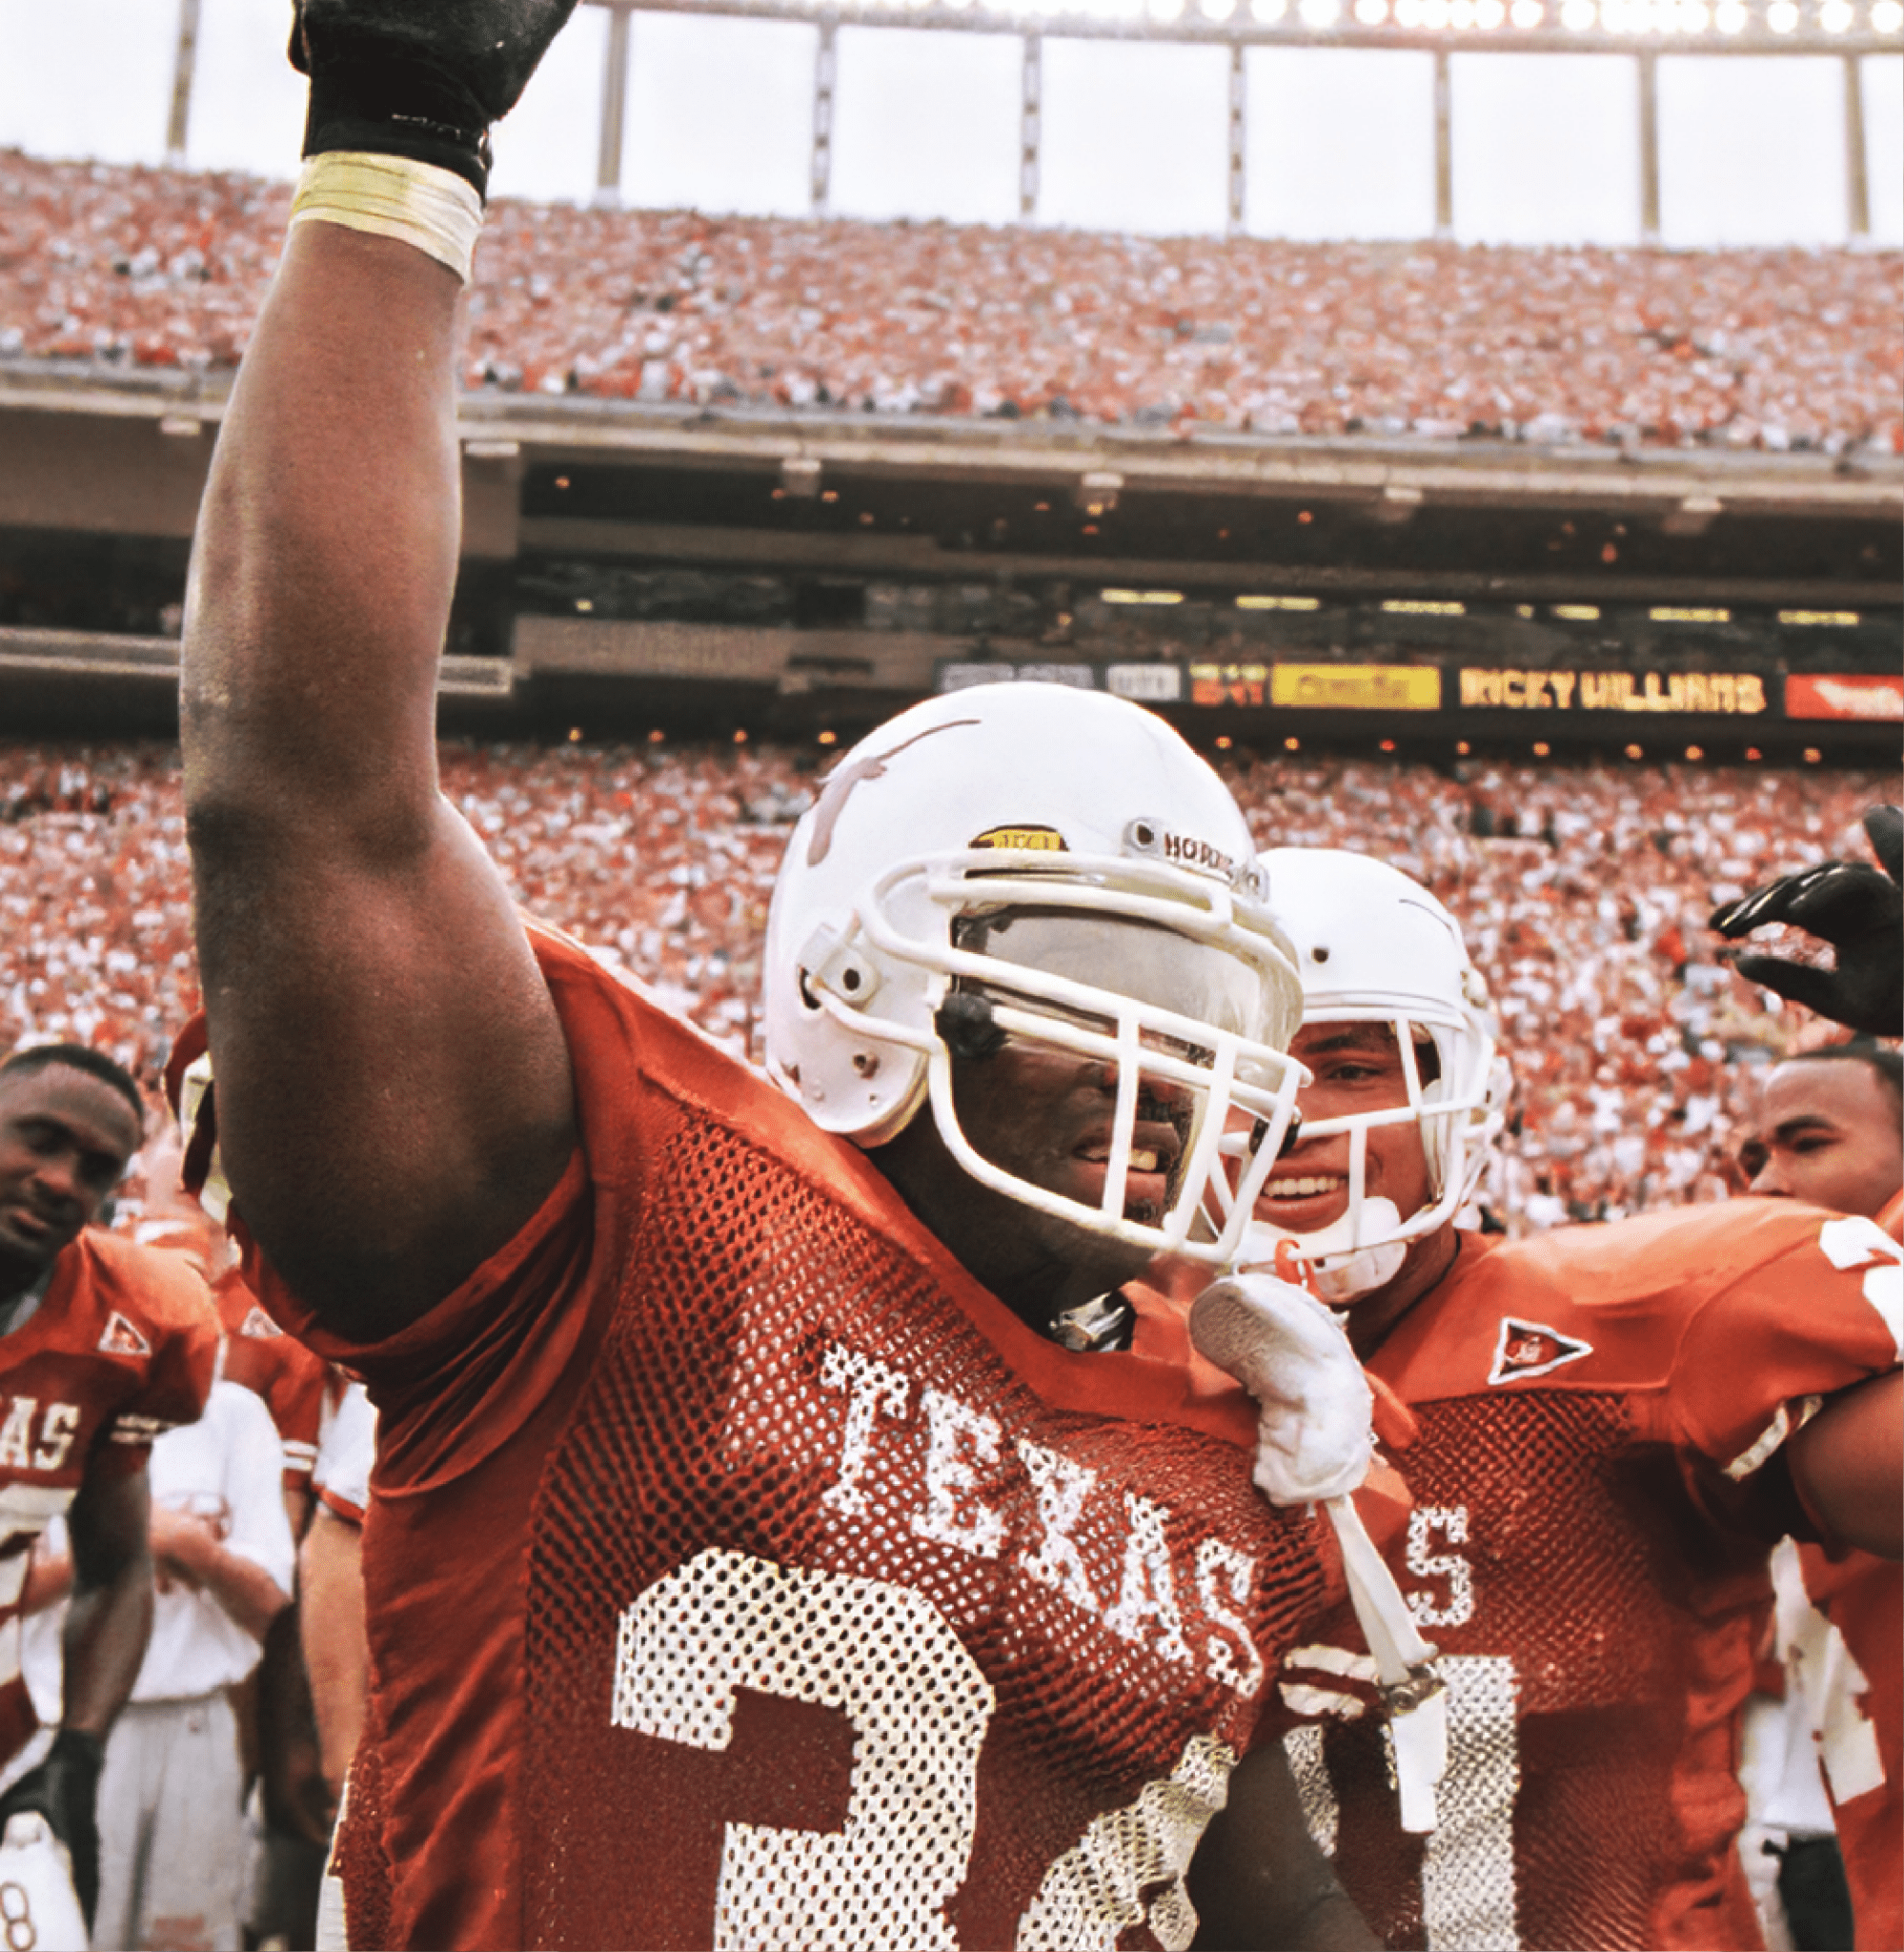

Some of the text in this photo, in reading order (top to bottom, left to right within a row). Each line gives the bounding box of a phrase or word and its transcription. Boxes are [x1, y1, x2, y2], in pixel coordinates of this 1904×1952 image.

[1460, 668, 1575, 709] RICKY
[1580, 670, 1767, 713] WILLIAMS
[819, 1344, 1264, 1699] TEXAS
